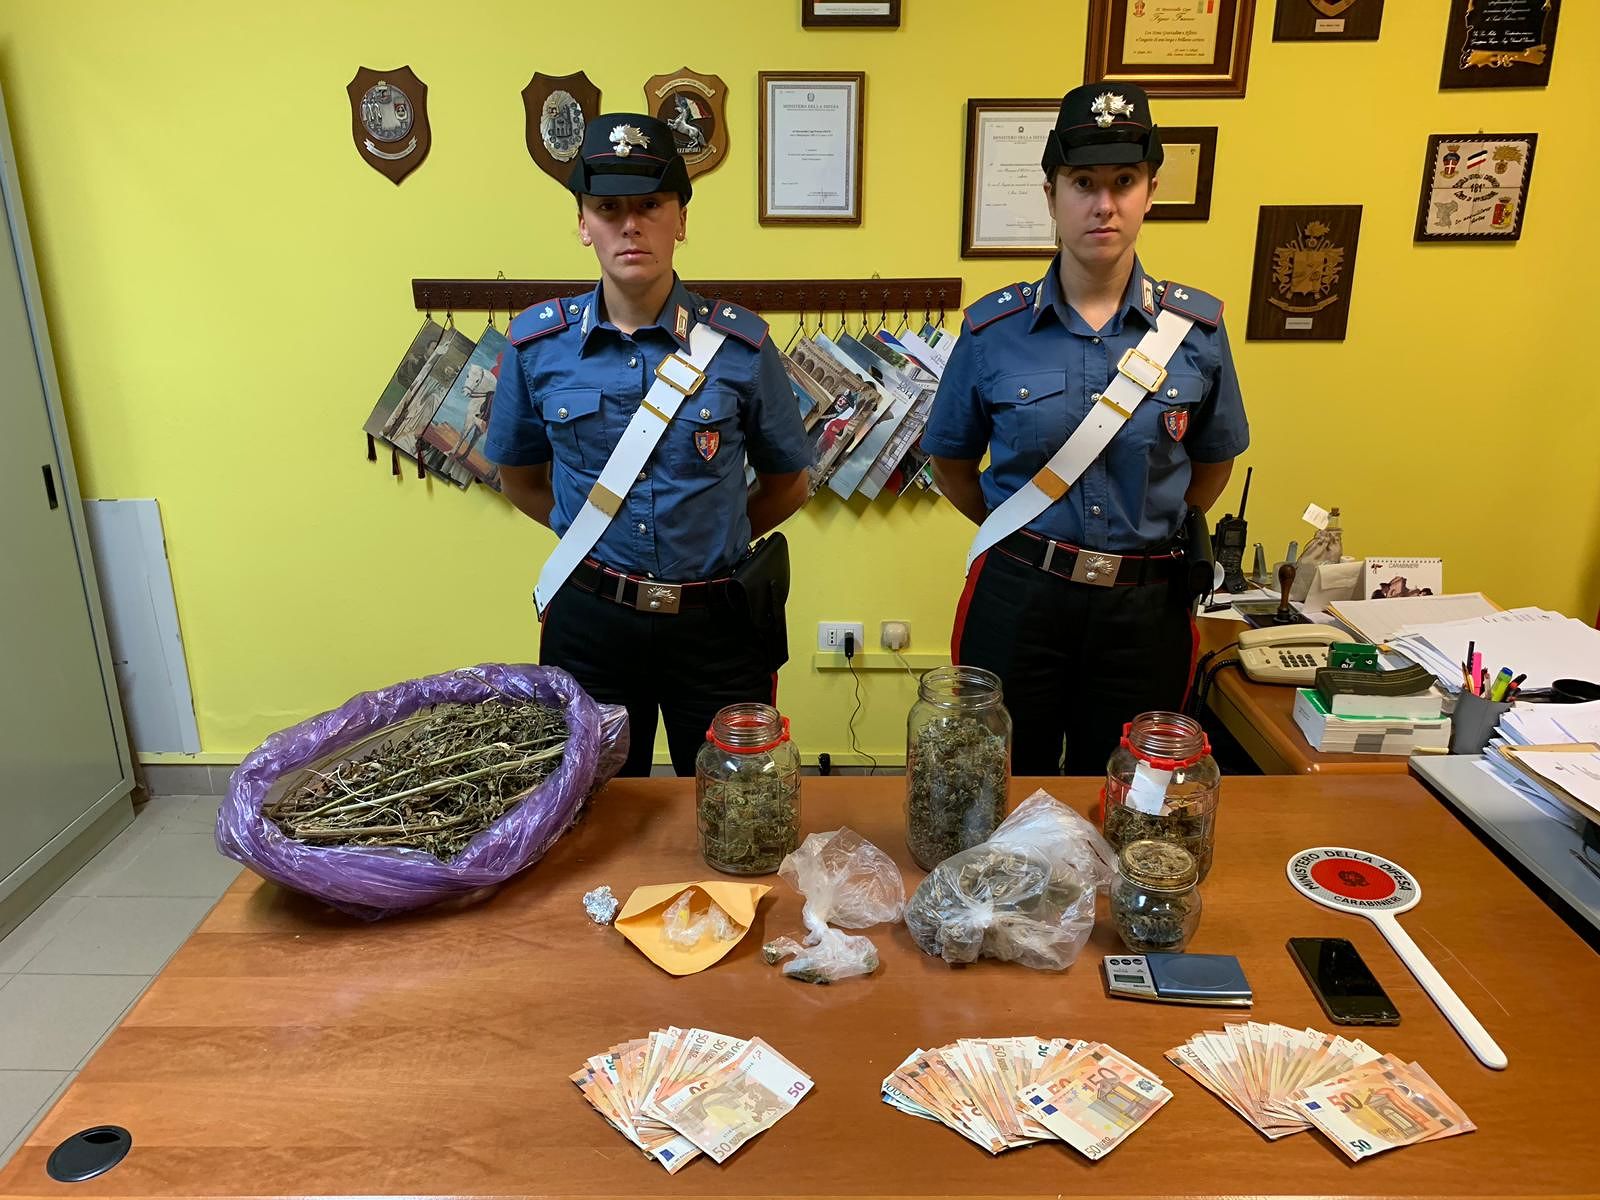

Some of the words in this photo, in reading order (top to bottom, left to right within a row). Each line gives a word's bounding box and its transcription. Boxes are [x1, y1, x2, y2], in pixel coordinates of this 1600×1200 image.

[1295, 853, 1320, 890] MINISTERO
[1324, 850, 1373, 863] DELLA
[1379, 863, 1413, 891] DIFESA
[1334, 895, 1402, 907] CARABINIERI
[1086, 1067, 1121, 1092] 50
[787, 1081, 806, 1098] 50
[1326, 1092, 1363, 1114] 50
[712, 1141, 732, 1159] 50
[1084, 1144, 1102, 1158] 50
[1349, 1139, 1372, 1153] 50
